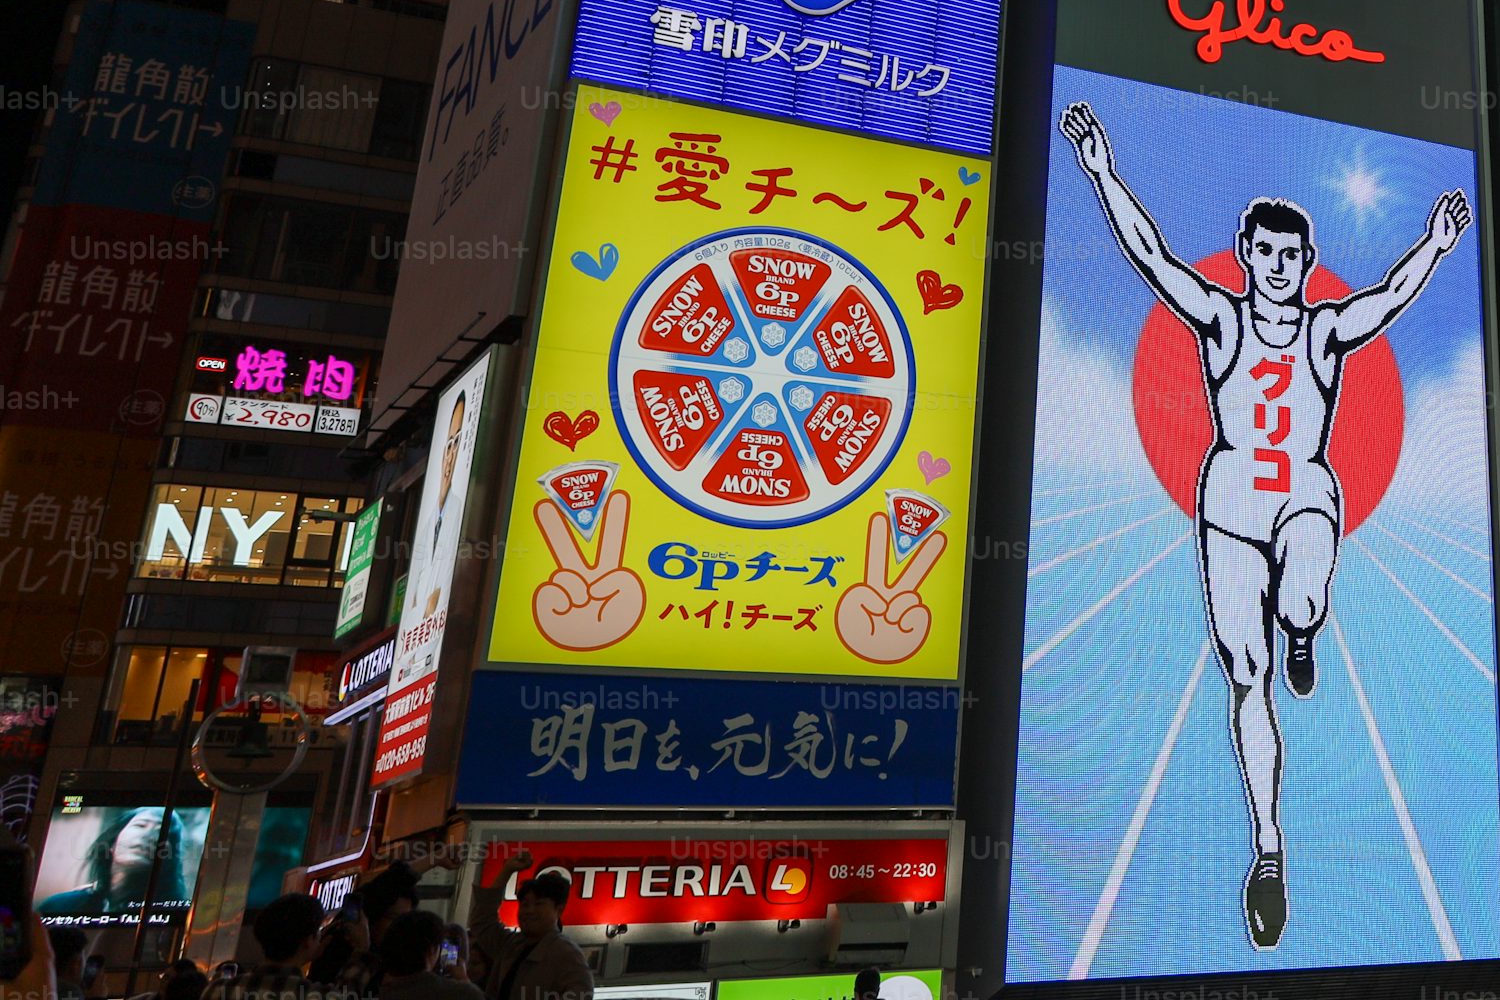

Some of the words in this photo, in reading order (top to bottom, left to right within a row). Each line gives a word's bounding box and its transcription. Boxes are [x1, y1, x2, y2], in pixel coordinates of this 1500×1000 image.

[649, 5, 951, 98] 雪印メグミルク
[747, 255, 817, 281] SNOW
[651, 274, 706, 339] SNOW
[755, 303, 797, 319] CHEESE
[699, 316, 732, 353] CHEESE
[815, 330, 841, 370] CHEESE
[847, 302, 889, 365] SNOW
[198, 358, 226, 370] OPEN
[232, 345, 355, 401] 焼肉
[640, 385, 686, 452] SNOW
[695, 379, 721, 422] CHEESE
[806, 394, 837, 432] CHEESE
[741, 431, 784, 447] CHEESE
[833, 408, 882, 474] SNOW
[1249, 354, 1296, 494] グリコ
[561, 472, 600, 488] SNOW
[718, 474, 792, 498] SNOW
[900, 500, 933, 518] SNOW
[658, 599, 824, 632] ハイ!チーズ
[348, 638, 394, 695] LOTTERIA
